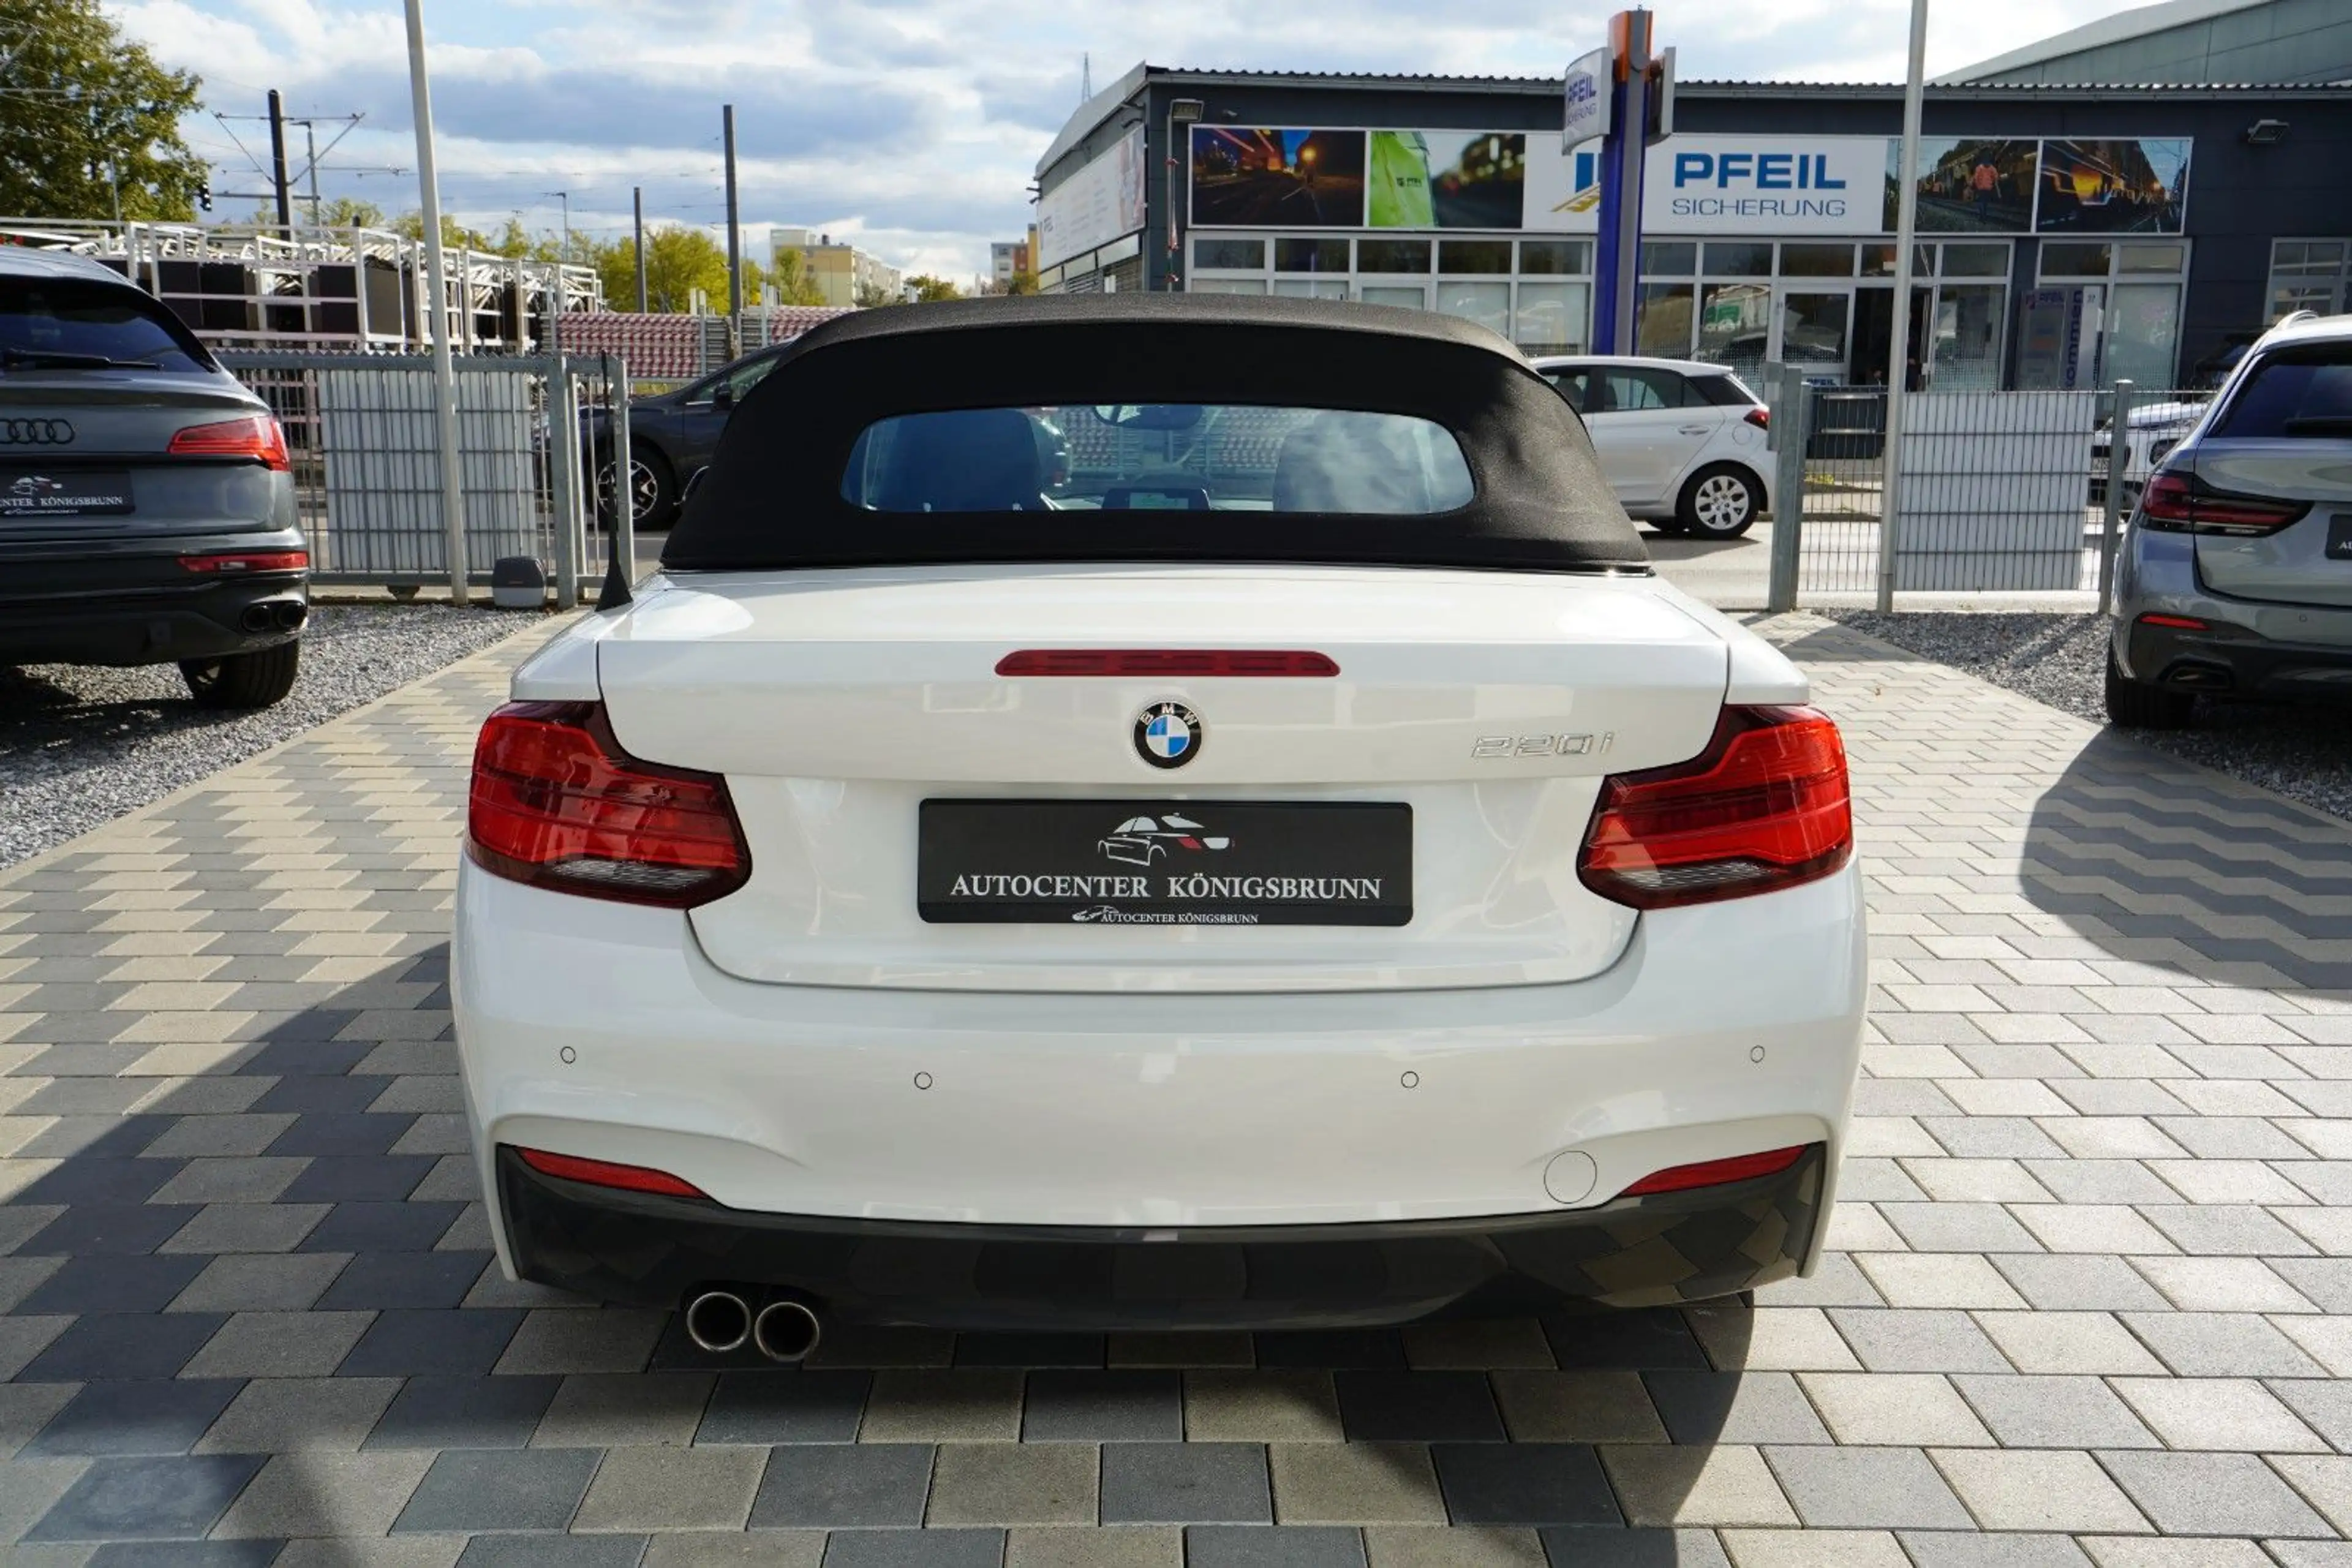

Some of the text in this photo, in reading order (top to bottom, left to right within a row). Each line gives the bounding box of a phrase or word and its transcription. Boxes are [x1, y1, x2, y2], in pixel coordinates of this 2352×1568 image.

[1675, 153, 1846, 189] PFEIL
[1672, 198, 1846, 217] SICHERUNG
[40, 496, 123, 507] KÖNIGSBRUNN
[1139, 703, 1198, 725] BMW
[1471, 732, 1615, 757] 220i
[950, 873, 1382, 899] AUTOCENTER KÖNIGSBRUNN
[1101, 912, 1259, 924] AUTOCENTER KÖNIGSBRUNN
